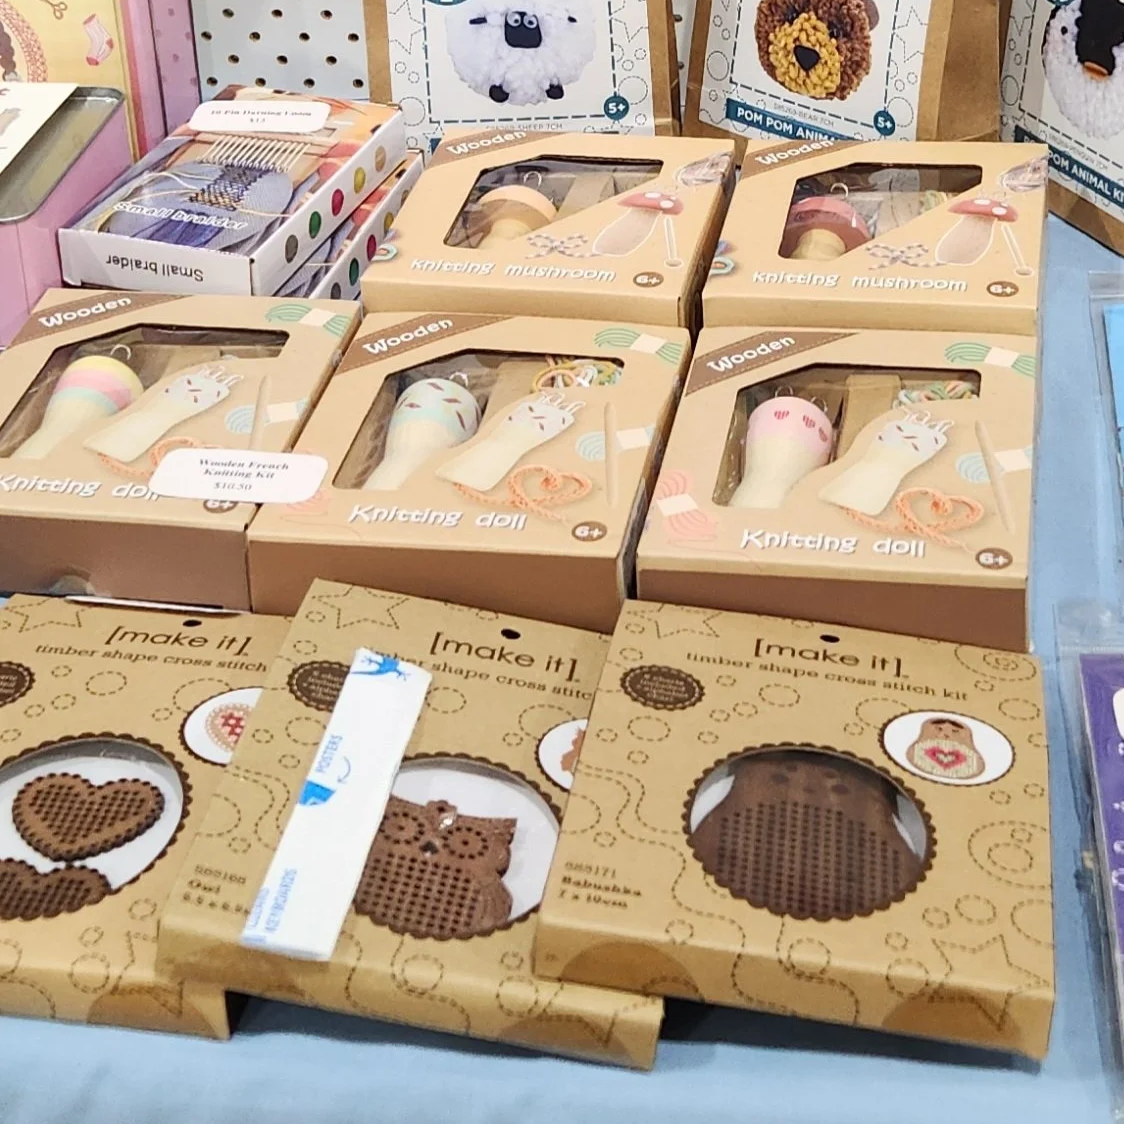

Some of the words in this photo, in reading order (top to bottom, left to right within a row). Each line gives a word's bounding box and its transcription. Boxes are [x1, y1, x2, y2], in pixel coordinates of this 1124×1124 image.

[607, 101, 626, 114] 5+
[447, 130, 527, 157] Wooden
[755, 139, 834, 166] Wooden
[1071, 162, 1111, 200] ANIMAL
[114, 200, 171, 222] Small
[175, 208, 249, 230] braider
[106, 254, 158, 275] braider
[162, 264, 204, 282] Small
[38, 296, 132, 328] Wooden
[362, 317, 454, 356] Wooden
[706, 333, 795, 374] Wooden
[199, 458, 245, 469] Wooden
[248, 460, 289, 471] French
[203, 467, 262, 480] Knitting
[263, 469, 275, 479] Kit
[347, 503, 463, 528] Knitting
[475, 511, 528, 531] doll
[576, 524, 604, 538] 6+
[740, 529, 859, 555] Knitting
[873, 536, 926, 558] doll
[978, 552, 1008, 566] 6+
[35, 643, 97, 661] timber
[101, 647, 157, 665] shape
[163, 654, 211, 669] cross
[215, 657, 268, 673] stitch
[754, 638, 860, 668] [make
[869, 654, 909, 679] it]
[687, 651, 753, 670] timber
[758, 660, 820, 680] shape
[824, 670, 878, 687] cross
[883, 677, 937, 697] stitch
[942, 687, 969, 703] kit
[560, 875, 642, 897] Babushka
